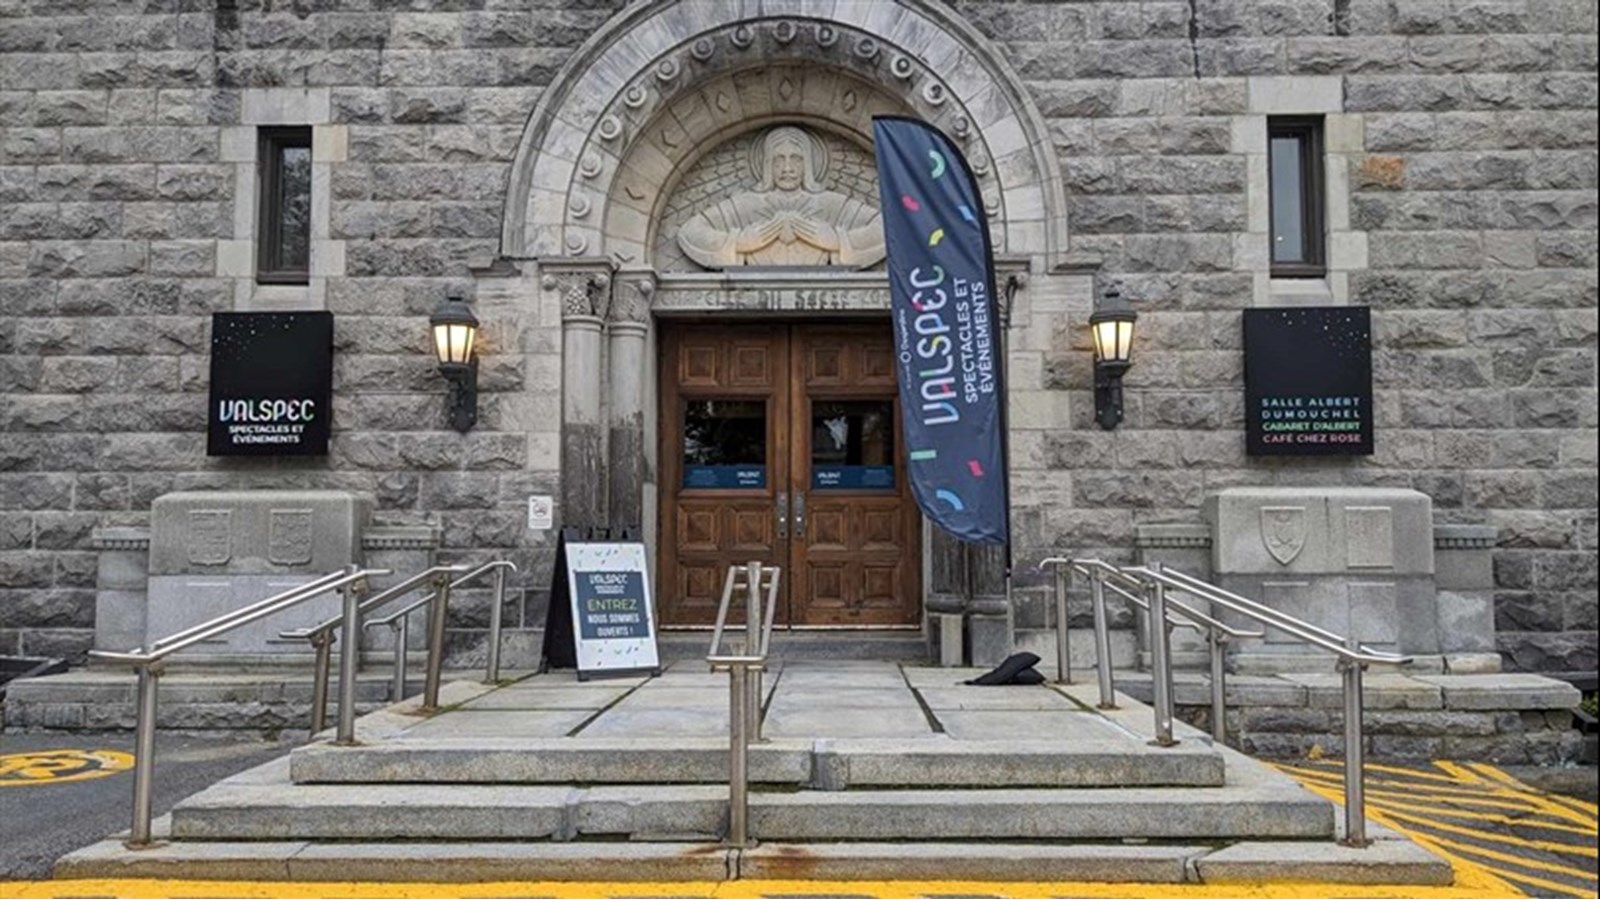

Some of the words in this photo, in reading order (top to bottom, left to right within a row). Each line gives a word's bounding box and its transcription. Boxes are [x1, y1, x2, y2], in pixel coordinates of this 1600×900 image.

[954, 277, 968, 298] ET
[971, 281, 994, 394] ÉVÉNEMENTS
[910, 265, 959, 425] VALSPEC
[956, 302, 978, 404] SPECTACLES
[1261, 398, 1303, 407] SALLE
[1308, 397, 1360, 407] ALBERT
[219, 399, 315, 422] VALSPEC
[1261, 409, 1360, 419] DUMOUCHEL
[228, 424, 290, 434] SPECTACLES
[291, 424, 304, 434] ET
[1262, 421, 1310, 431] CABARET
[1262, 433, 1293, 443] CAFÉ
[1296, 434, 1327, 443] CHEZ
[1329, 433, 1362, 443] ROSE
[587, 598, 638, 612] ENTREZ
[587, 613, 608, 624] NOUS
[608, 612, 640, 624] SOMMES
[597, 626, 629, 637] OUVERTS
